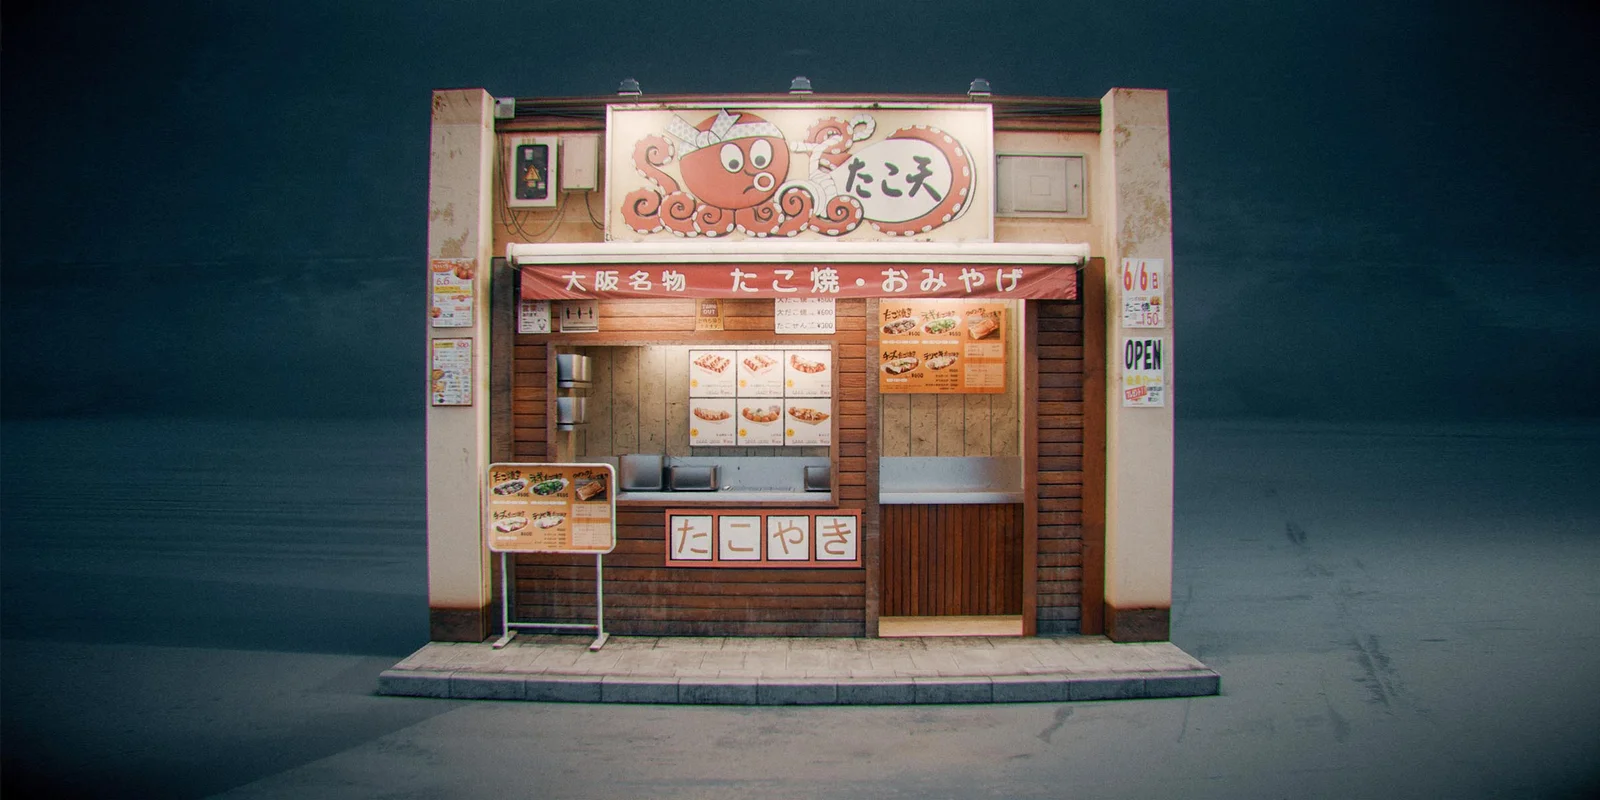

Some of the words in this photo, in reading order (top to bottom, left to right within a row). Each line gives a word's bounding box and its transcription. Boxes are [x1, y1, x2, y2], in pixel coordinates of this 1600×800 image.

[846, 156, 942, 202] たこ天
[562, 270, 686, 292] 大阪名物
[730, 267, 1023, 293] たこ焼・おみやげ
[883, 307, 912, 321] たこ焼き
[1141, 313, 1159, 326] 150
[1125, 339, 1162, 370] OPEN
[677, 518, 852, 555] たこやき
